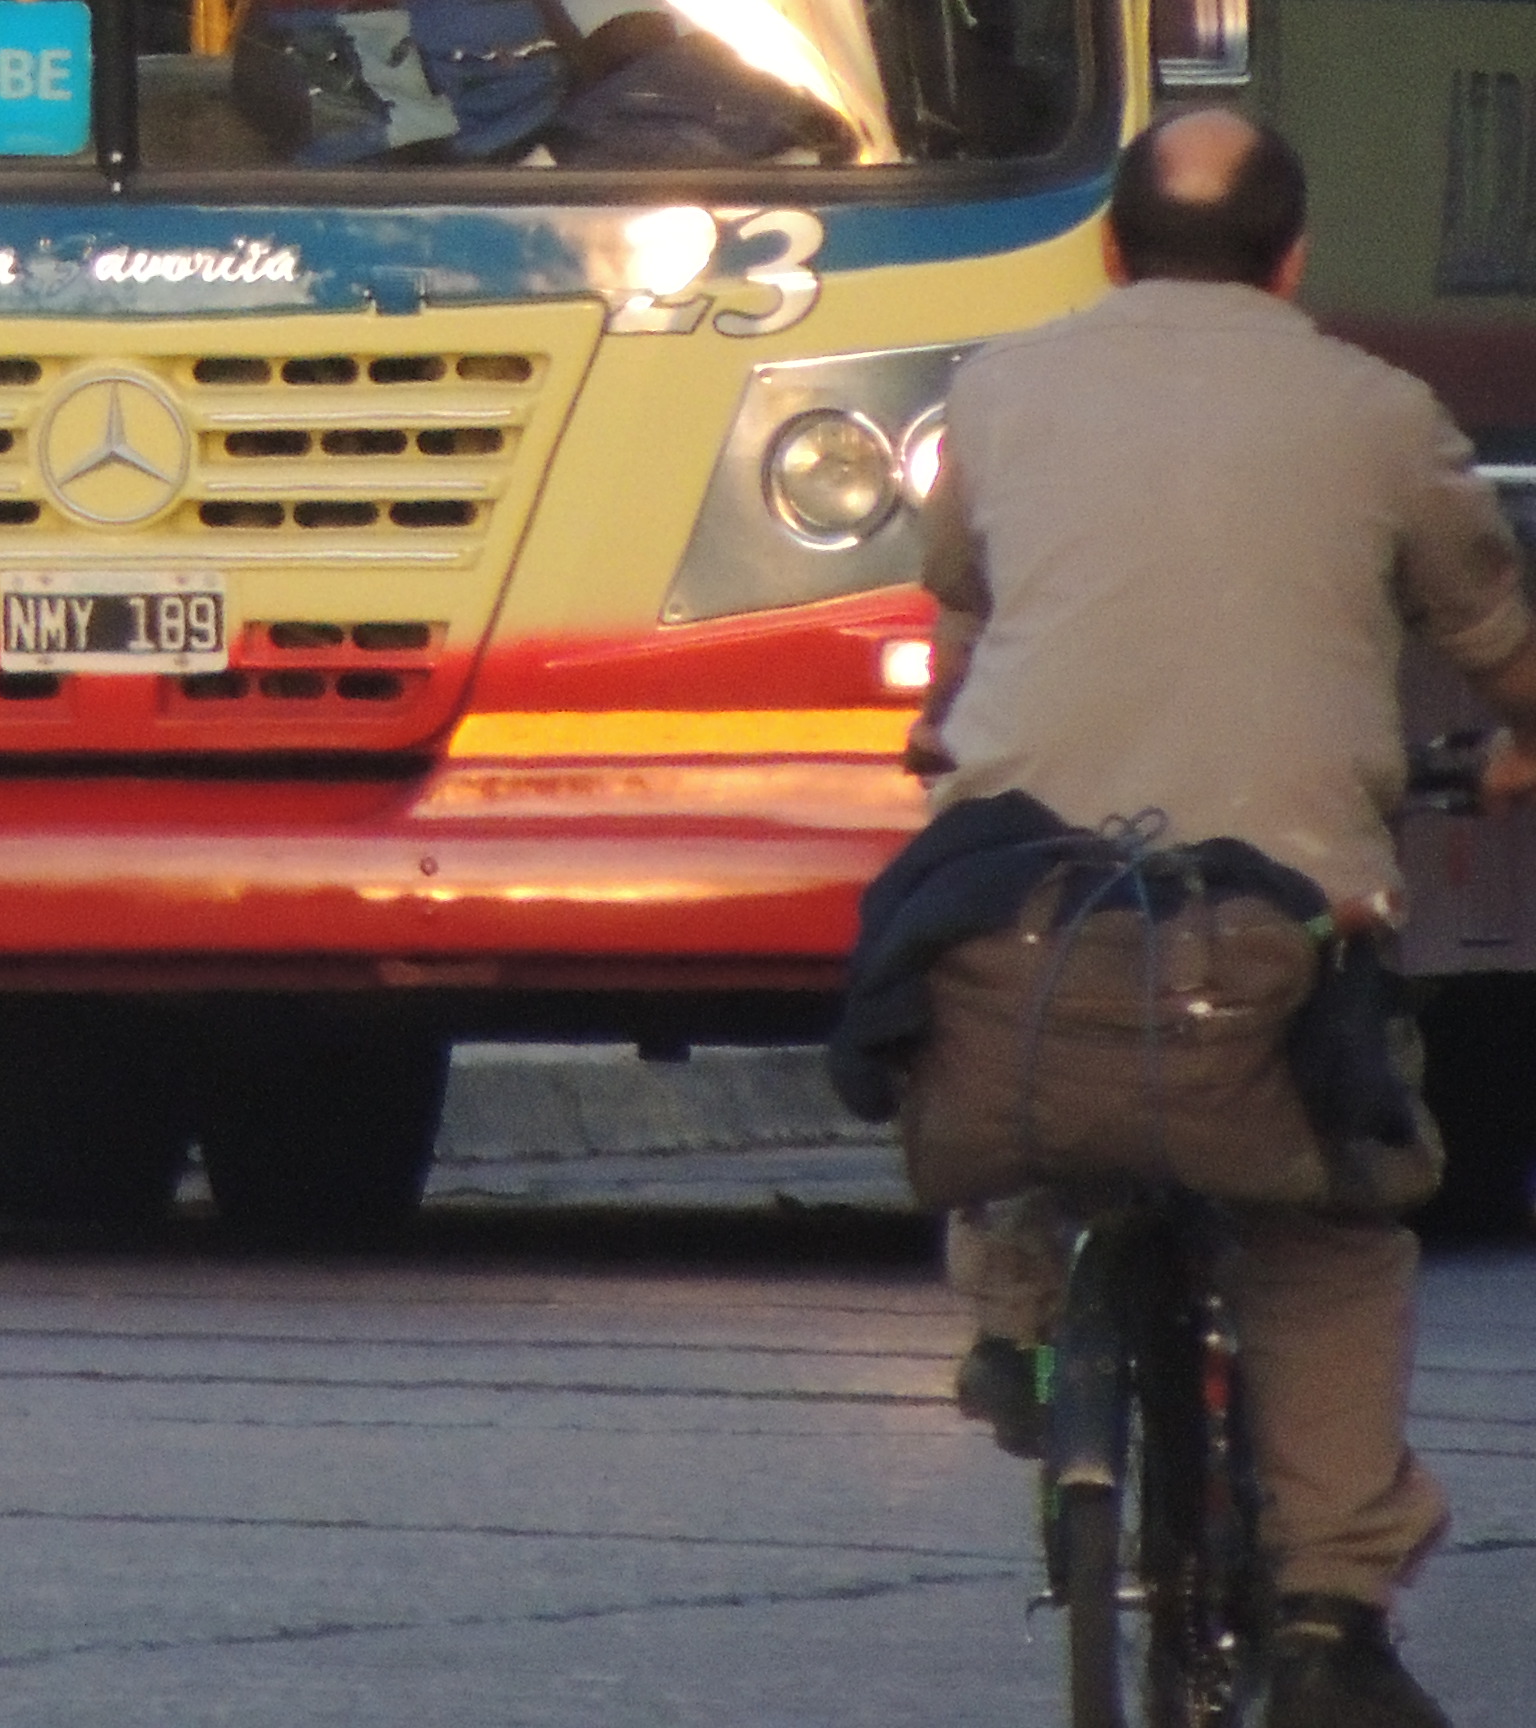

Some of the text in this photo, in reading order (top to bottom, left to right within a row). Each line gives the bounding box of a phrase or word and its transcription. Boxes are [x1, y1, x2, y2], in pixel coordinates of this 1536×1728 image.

[38, 232, 303, 285] avorita
[8, 596, 217, 651] NMY 189
